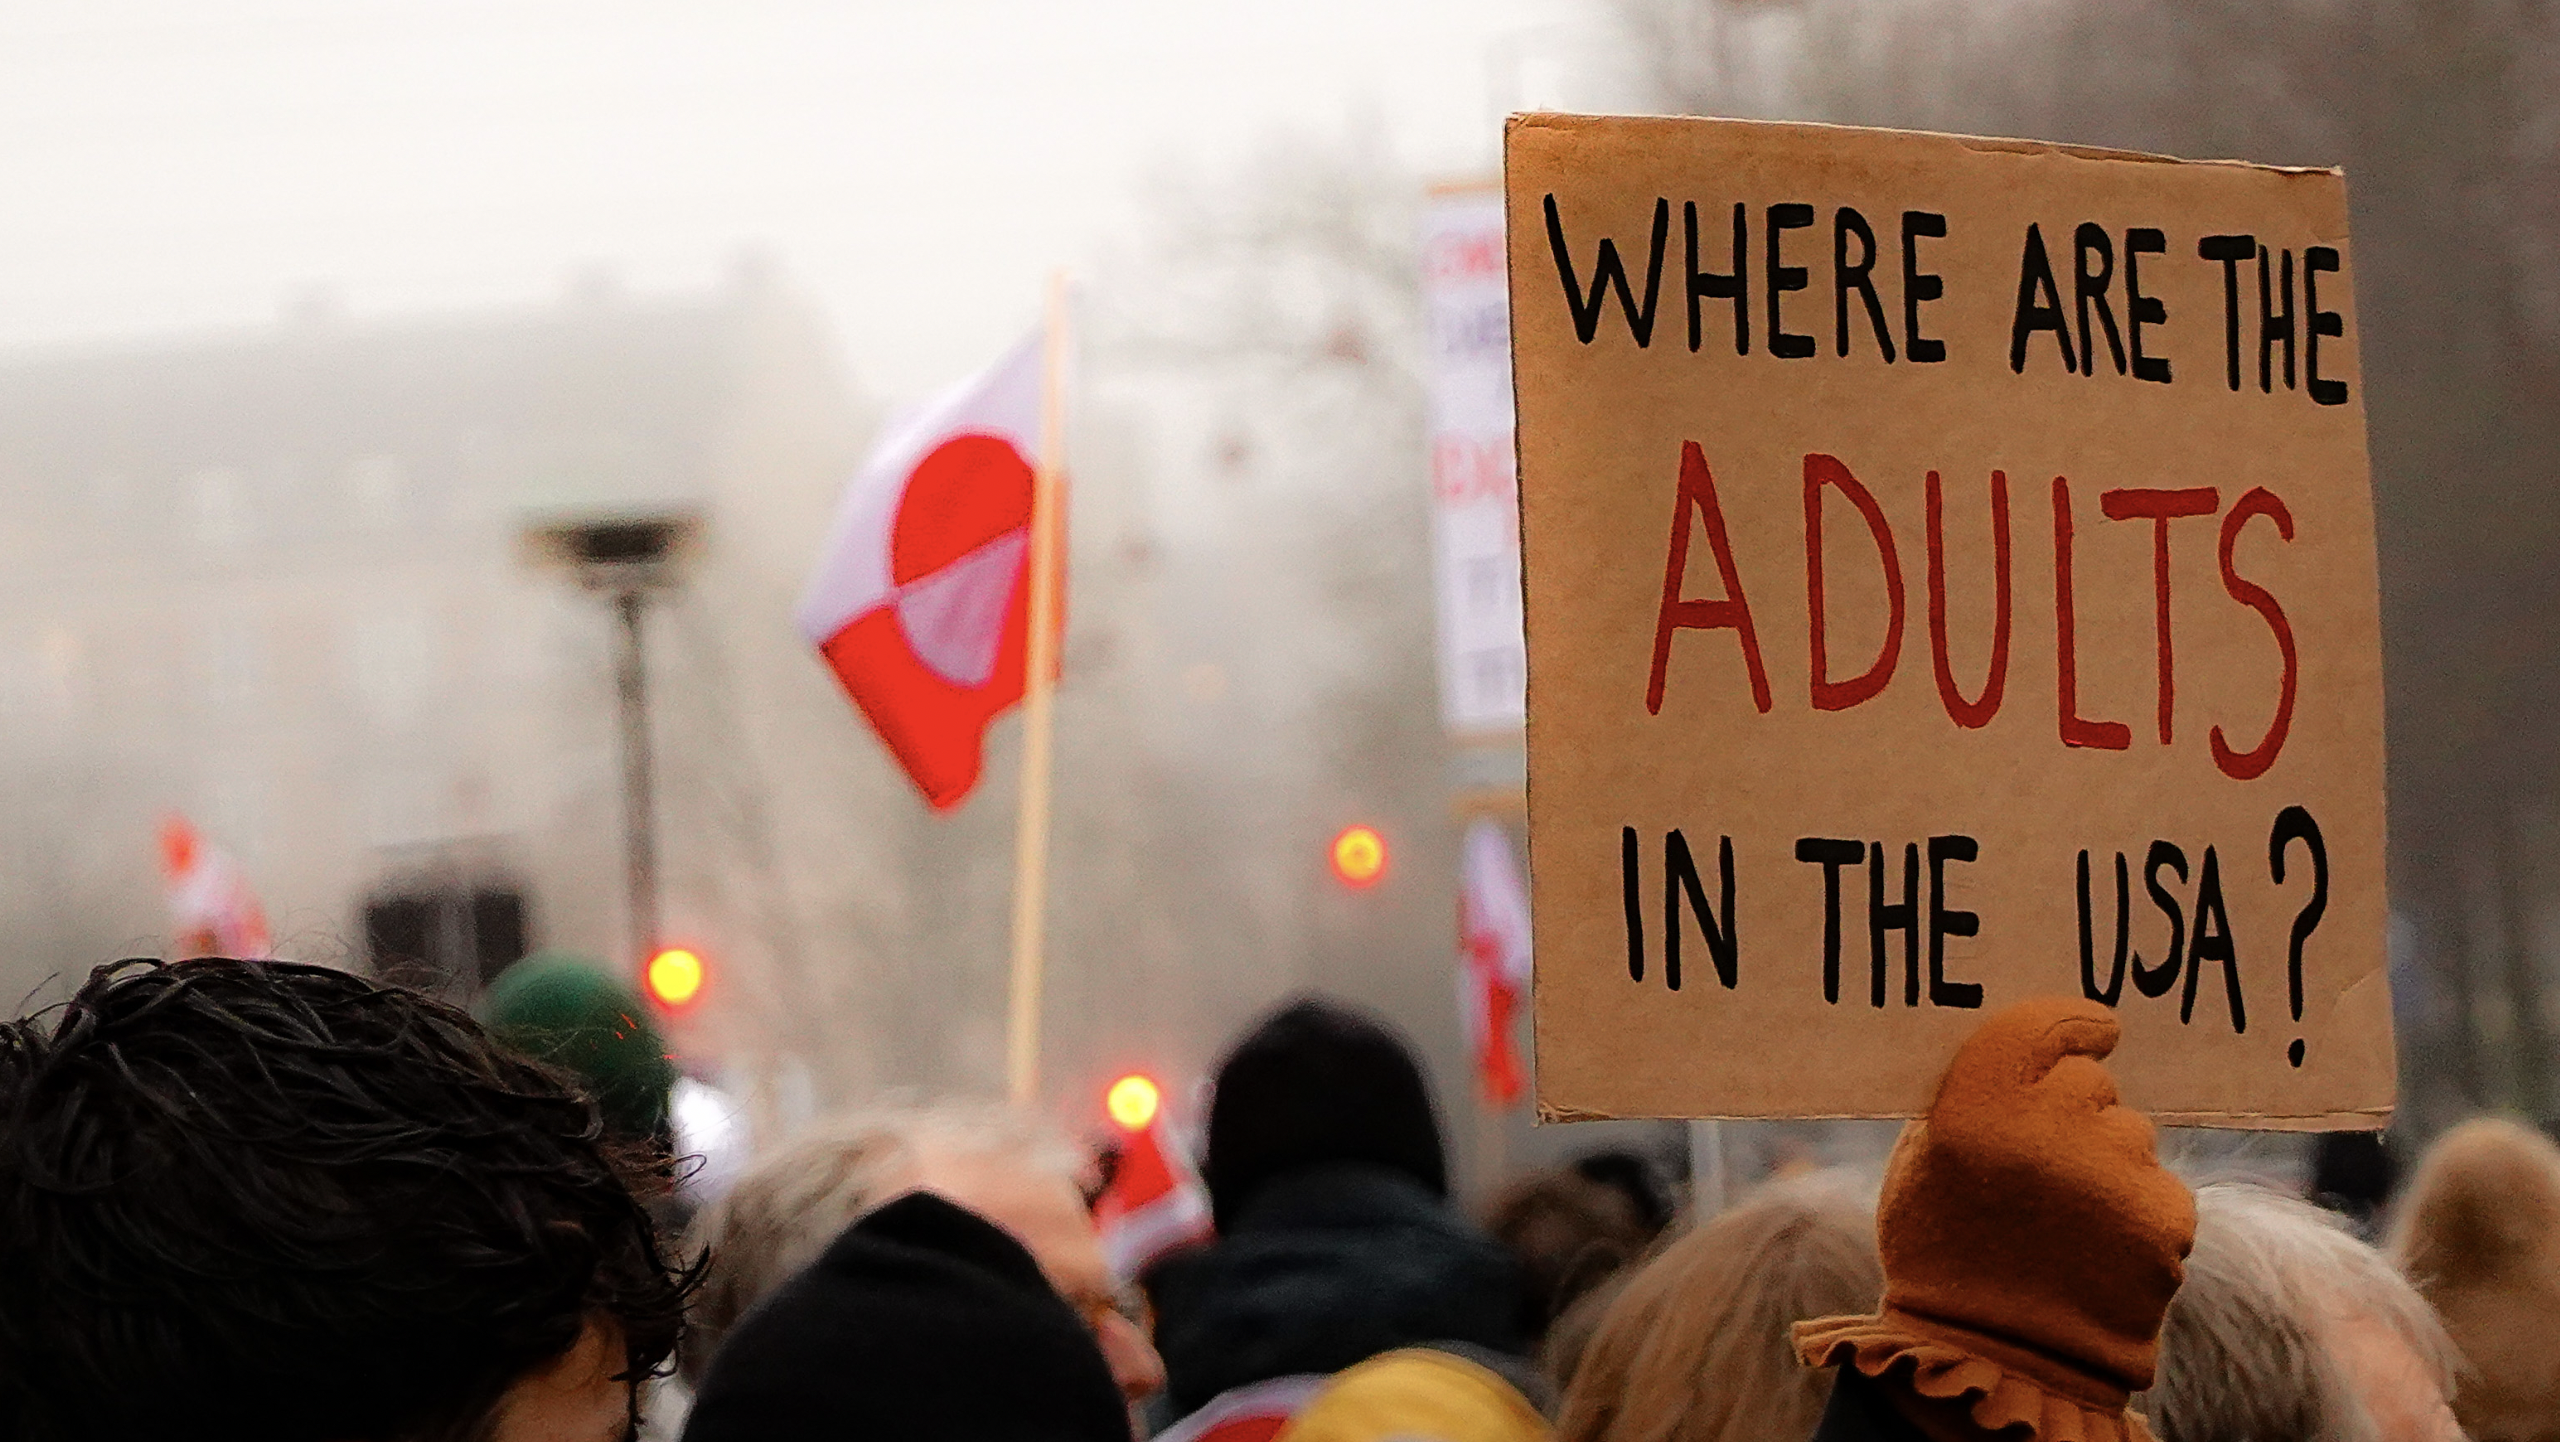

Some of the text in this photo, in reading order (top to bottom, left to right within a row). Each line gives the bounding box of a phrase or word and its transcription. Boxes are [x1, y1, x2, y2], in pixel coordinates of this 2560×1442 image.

[1542, 191, 2349, 407] WHERE ARE THE
[1644, 438, 2299, 782] ADULTS
[1621, 804, 2330, 1069] IN THE USA?
